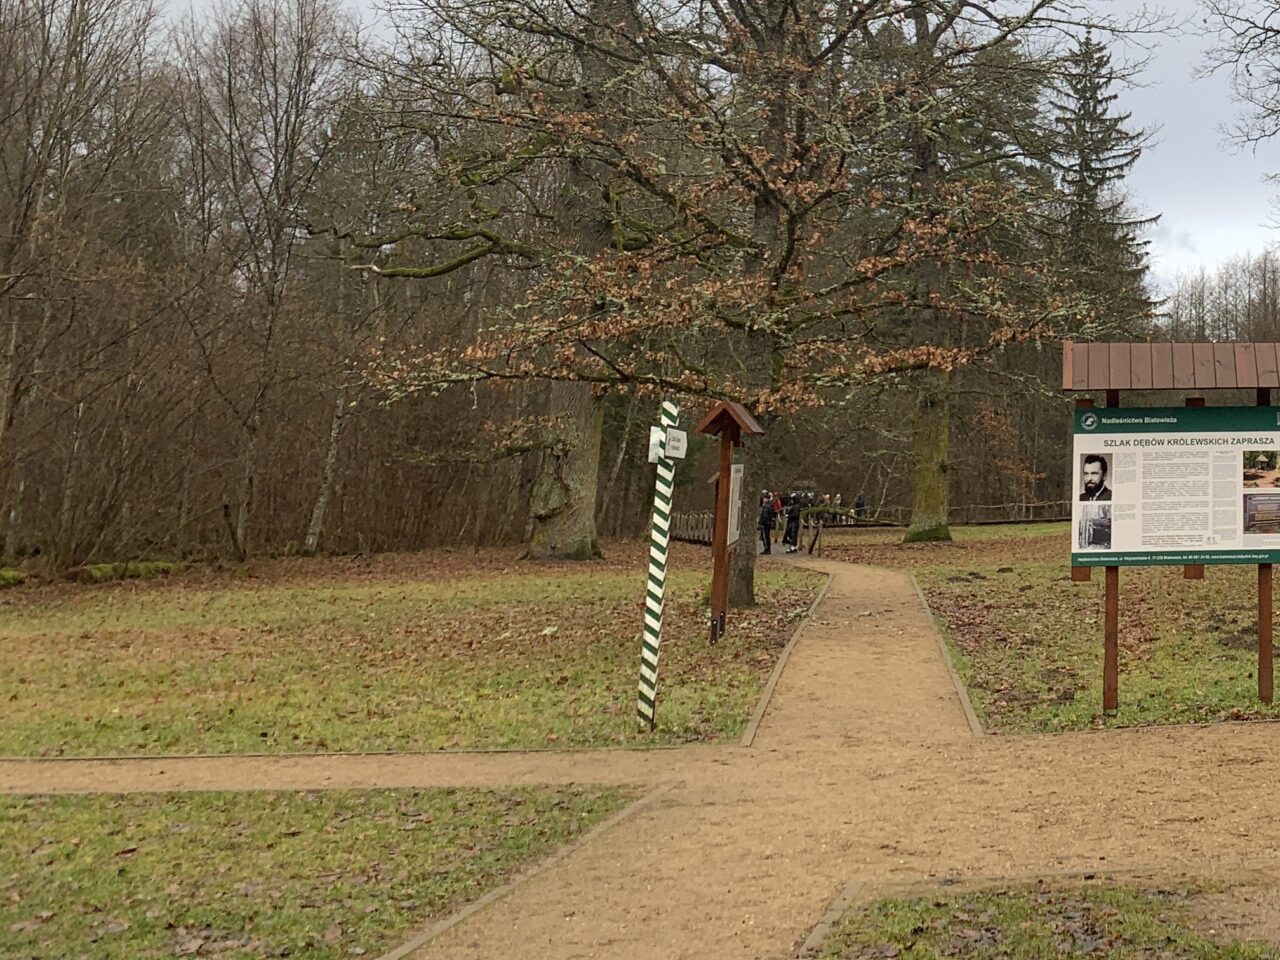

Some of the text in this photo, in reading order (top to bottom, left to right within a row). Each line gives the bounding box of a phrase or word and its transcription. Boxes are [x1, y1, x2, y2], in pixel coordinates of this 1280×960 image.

[1103, 437, 1275, 448] SZLAK DĘBÓW KRÓLEWSKICH ZAPRASZA
